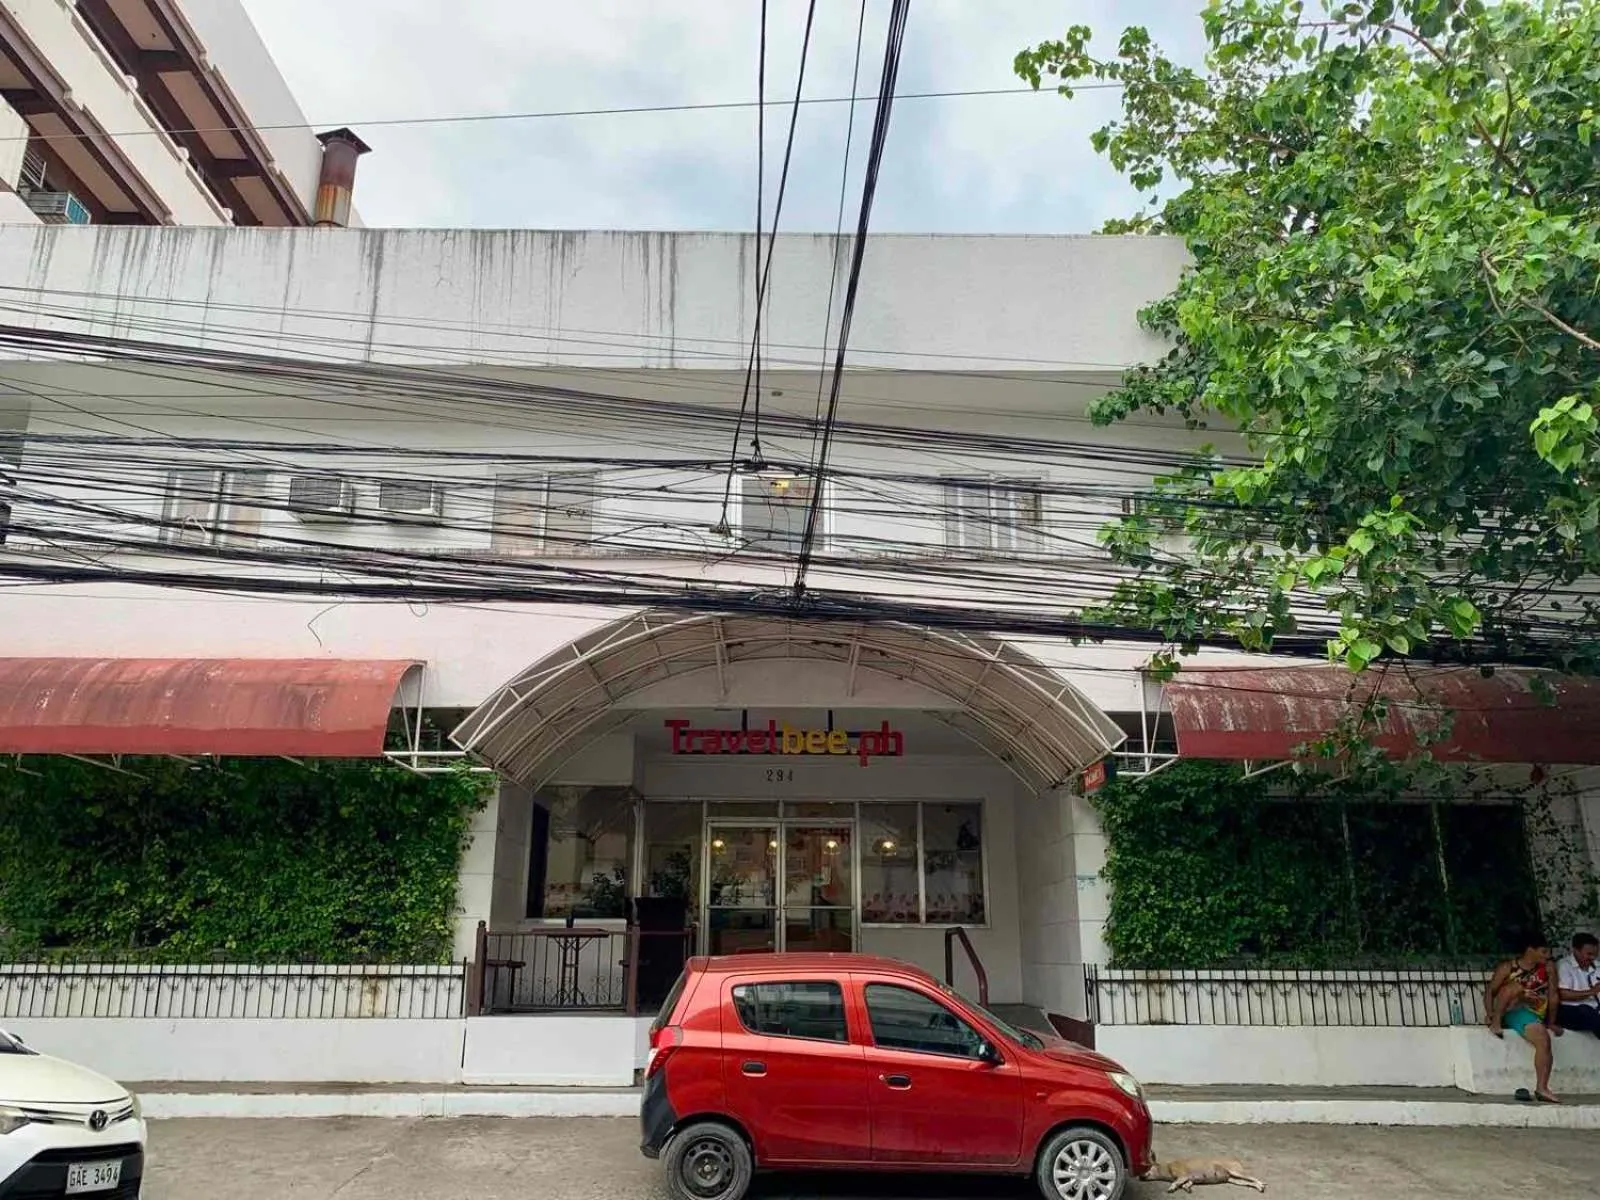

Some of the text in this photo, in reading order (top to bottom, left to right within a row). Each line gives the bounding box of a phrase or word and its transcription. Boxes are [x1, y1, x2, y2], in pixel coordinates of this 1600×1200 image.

[664, 719, 904, 767] Travelbee.ph
[766, 769, 794, 782] 294
[70, 1167, 118, 1187] GAE 3494
